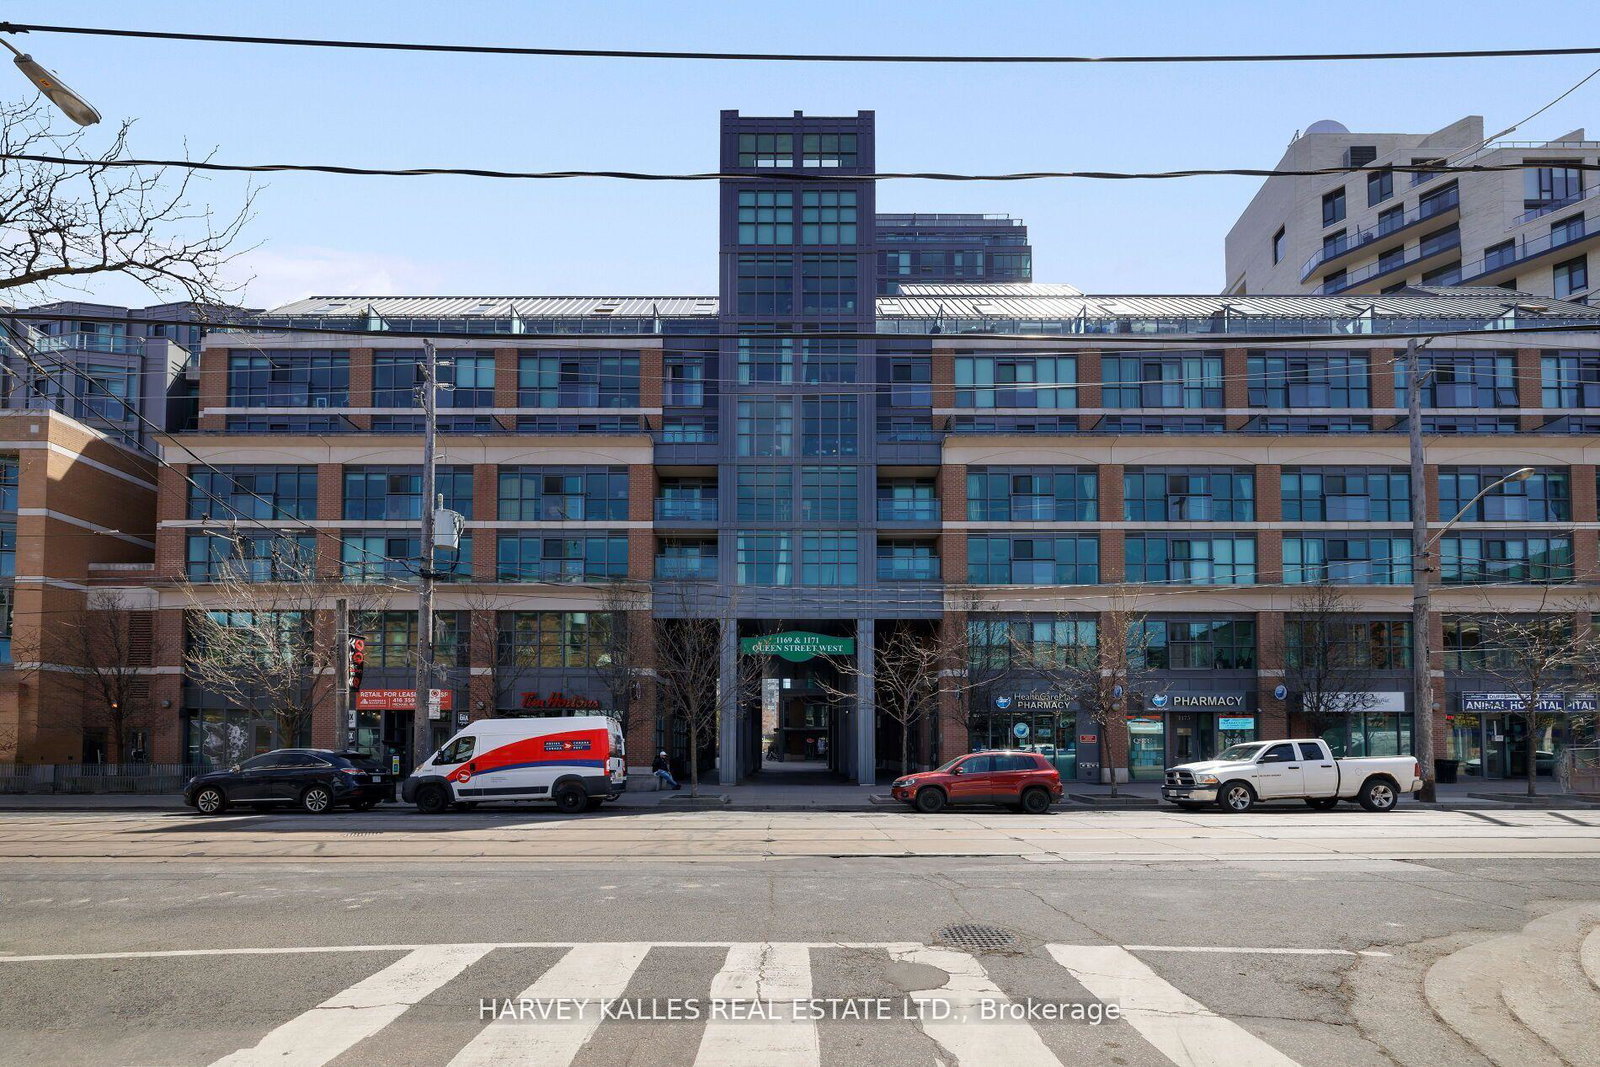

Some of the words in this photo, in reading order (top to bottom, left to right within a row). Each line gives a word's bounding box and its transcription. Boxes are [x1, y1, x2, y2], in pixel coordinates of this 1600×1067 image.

[1174, 696, 1242, 706] PHARMACY
[1466, 701, 1506, 710] ANIMAL
[1510, 700, 1562, 710] HOITAL
